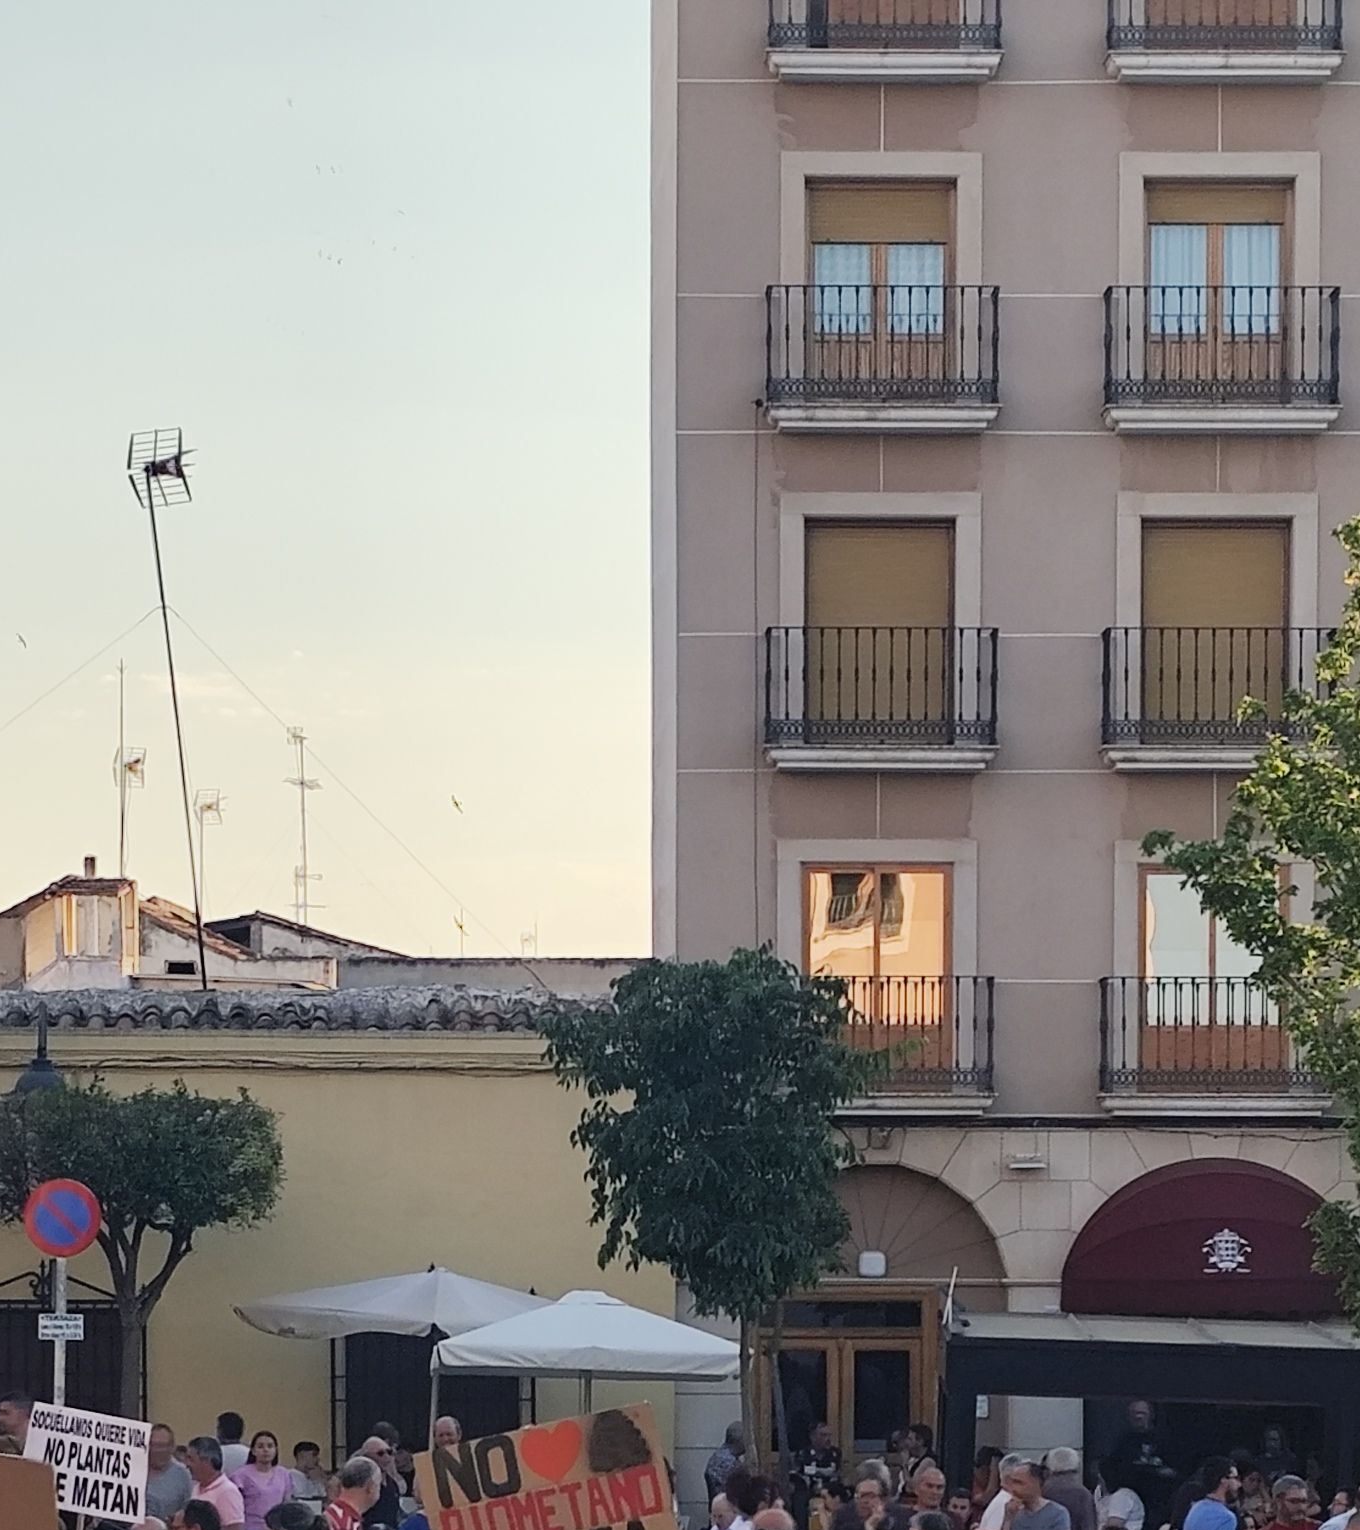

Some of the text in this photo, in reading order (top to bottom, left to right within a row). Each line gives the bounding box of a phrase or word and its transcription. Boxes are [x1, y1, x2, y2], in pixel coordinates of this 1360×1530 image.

[31, 1409, 93, 1439] SOCUÉLLAMOS
[95, 1421, 126, 1445] QUIERE
[43, 1437, 131, 1479] NO PLANTAS
[432, 1434, 521, 1509] NO
[72, 1475, 139, 1517] MATAN
